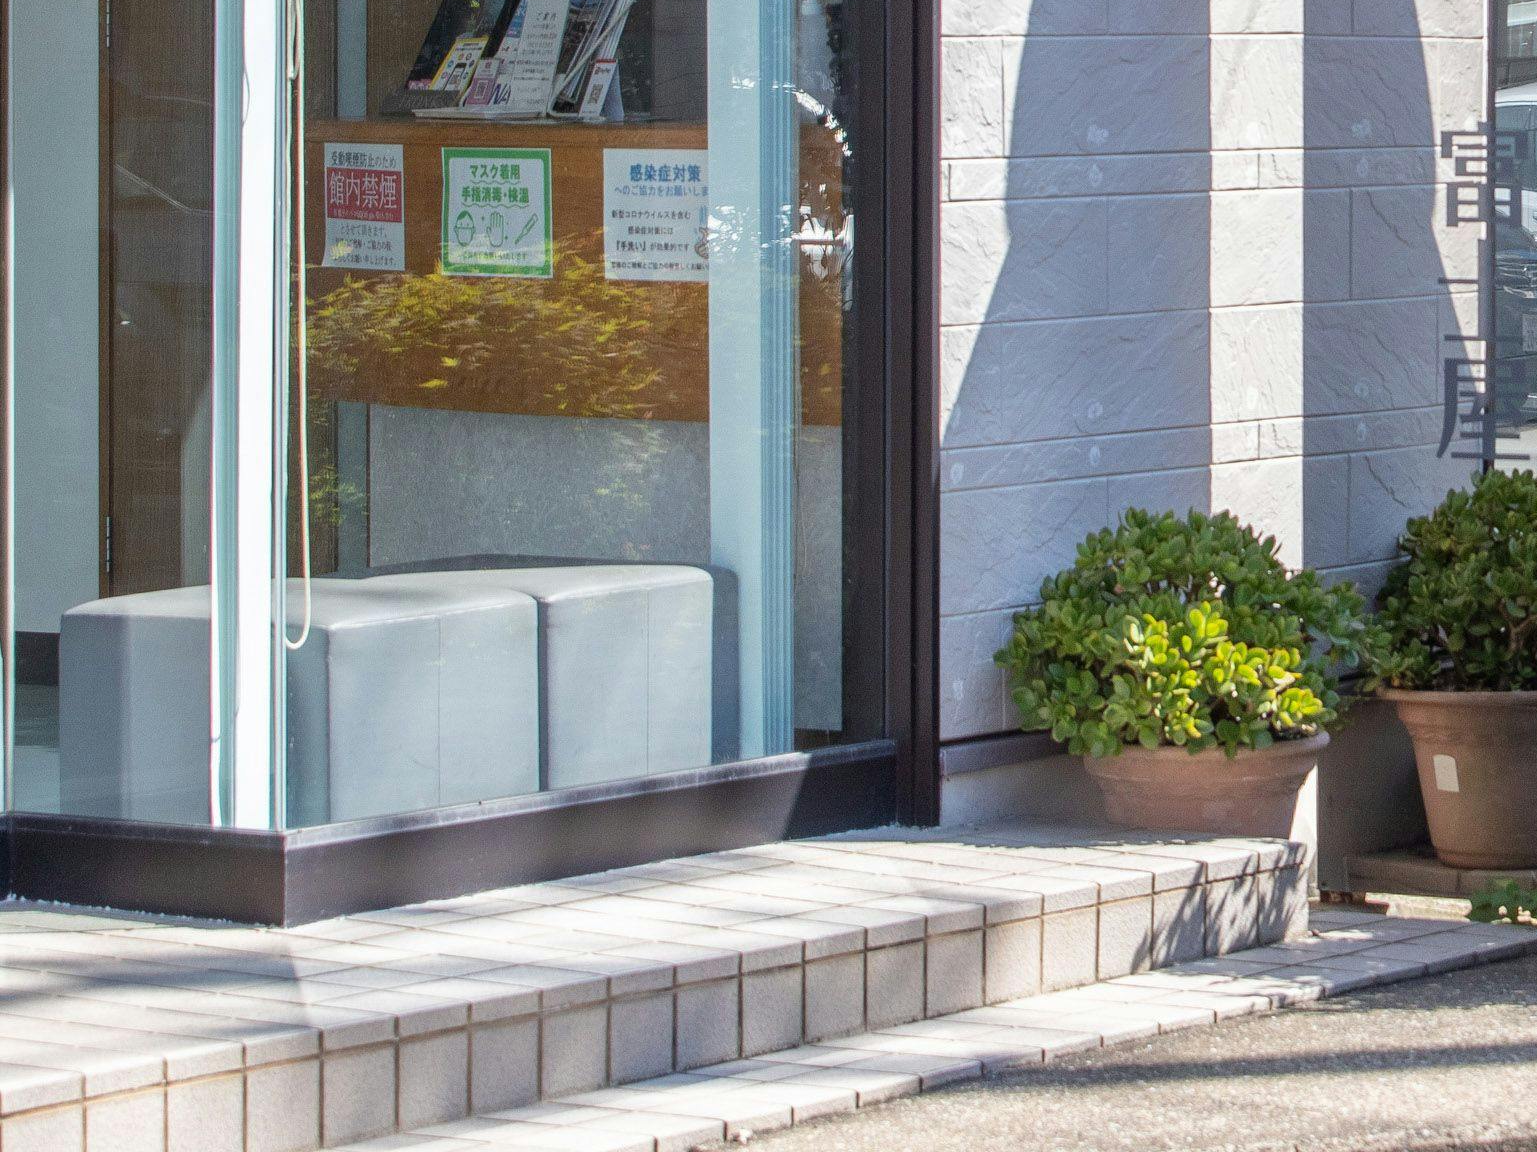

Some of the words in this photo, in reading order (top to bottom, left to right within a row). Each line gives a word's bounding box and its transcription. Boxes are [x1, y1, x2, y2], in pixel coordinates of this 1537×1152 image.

[470, 163, 520, 180] マスク着用
[630, 163, 701, 182] 感染症対策
[329, 170, 397, 209] 館内禁煙
[462, 186, 529, 203] 手指消毒・検温
[611, 210, 691, 219] 新型コロナウイルスを含む
[1436, 121, 1529, 460] 富士屋
